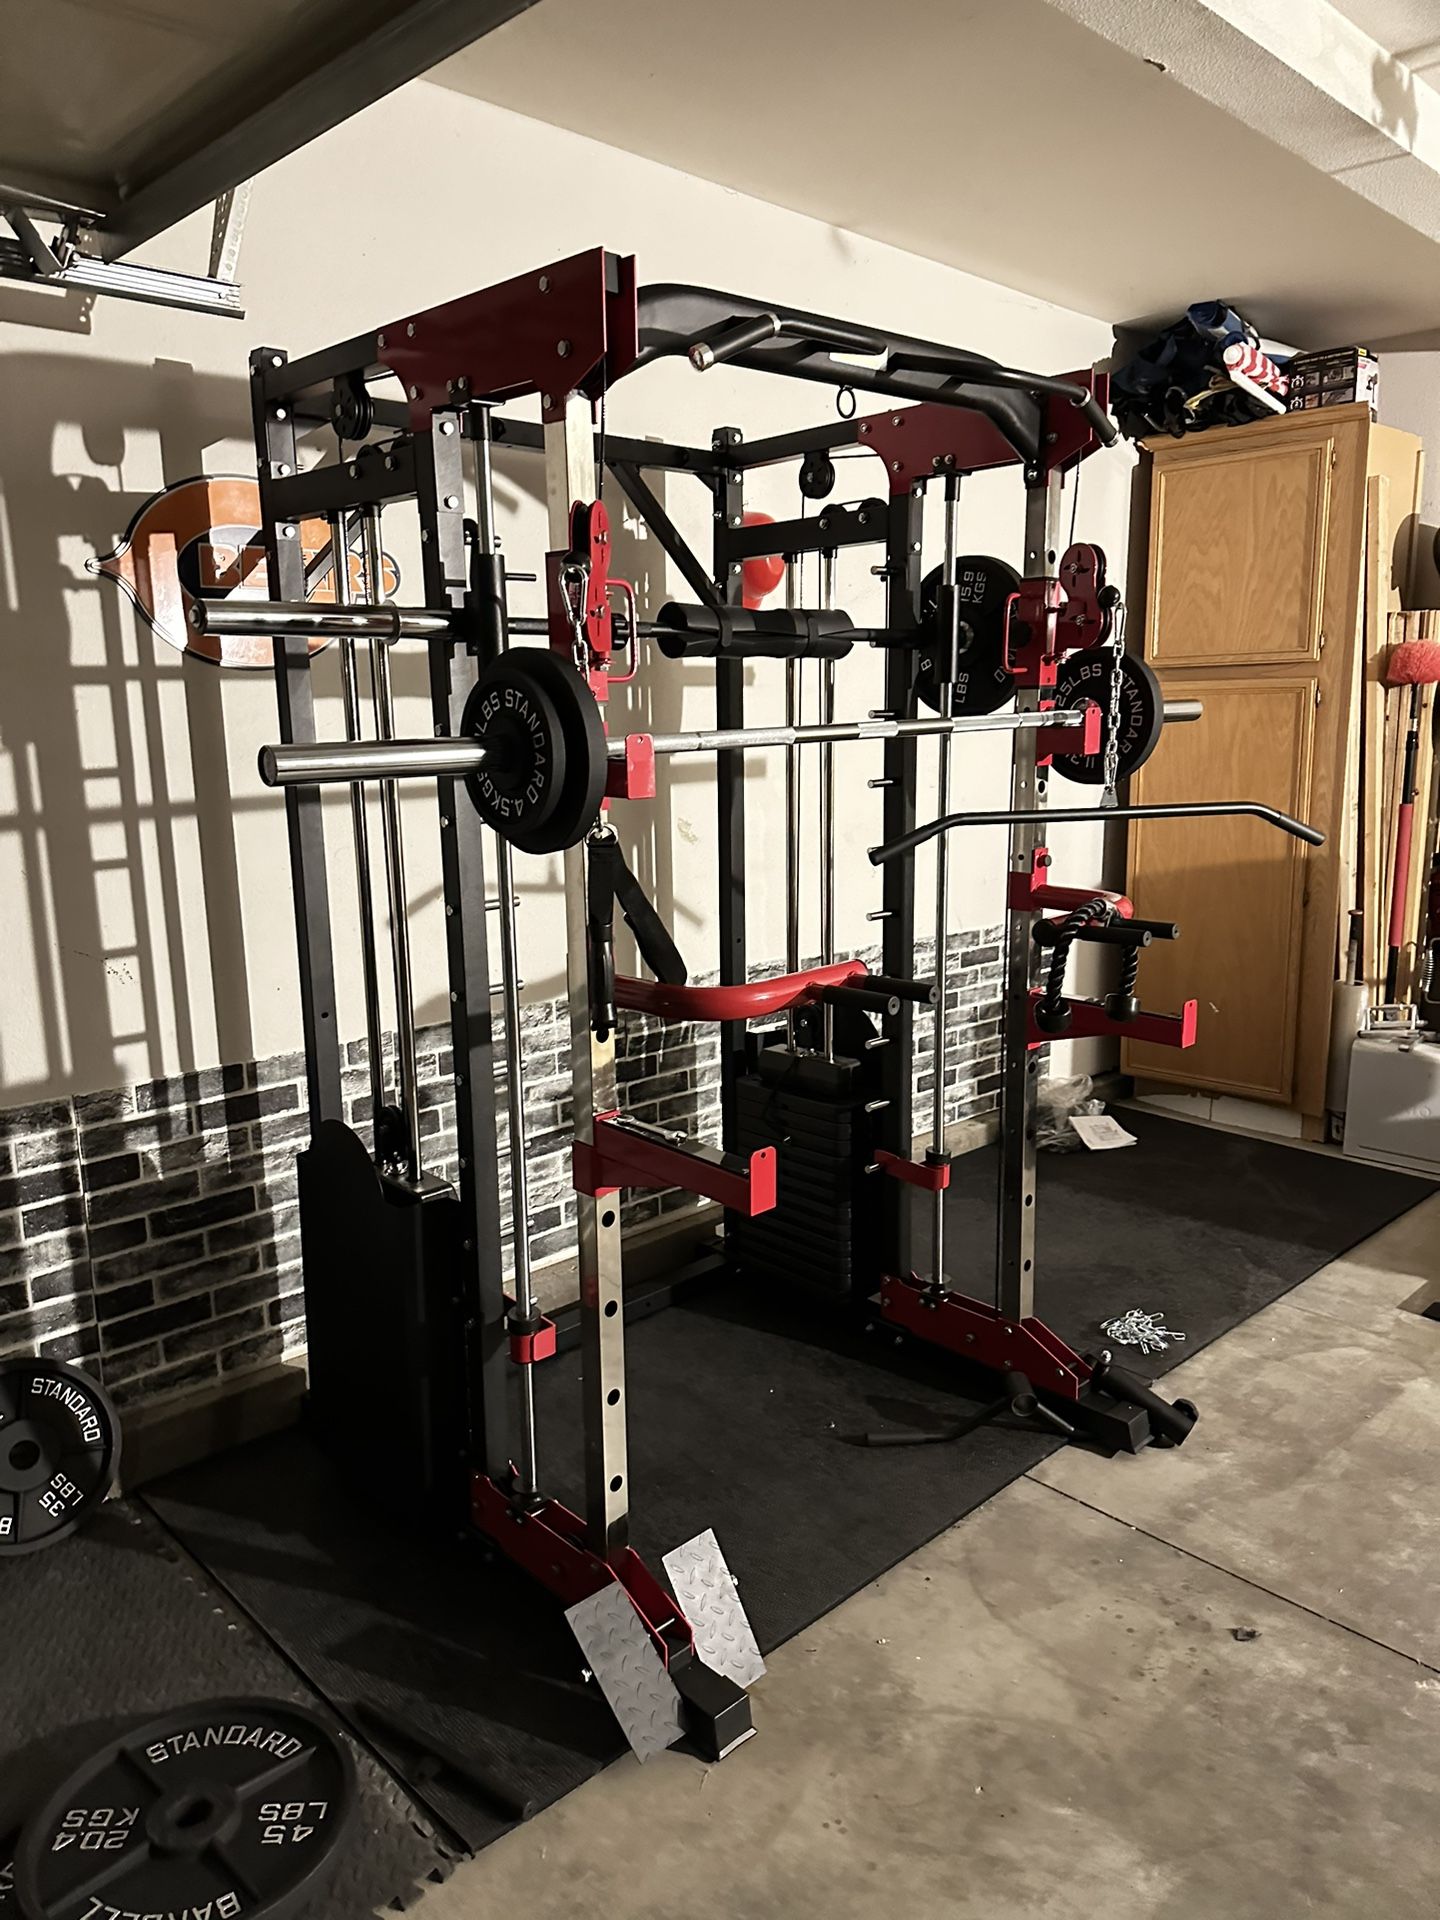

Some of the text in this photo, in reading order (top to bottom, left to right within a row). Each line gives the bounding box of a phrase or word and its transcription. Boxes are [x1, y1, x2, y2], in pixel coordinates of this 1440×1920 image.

[972, 571, 987, 603] KGS
[955, 672, 970, 704] LBS
[1054, 663, 1103, 708] 25LBS
[1112, 670, 1144, 760] TANDAR
[504, 688, 546, 805] STANDARD
[31, 1377, 101, 1443] STANDARD
[38, 1490, 65, 1518] 35
[50, 1472, 84, 1507] LBS
[146, 1724, 303, 1764] STANDARD
[61, 1806, 140, 1829] KGS
[258, 1801, 329, 1823] LBS
[52, 1829, 129, 1852] 20.4
[261, 1824, 314, 1845] 45
